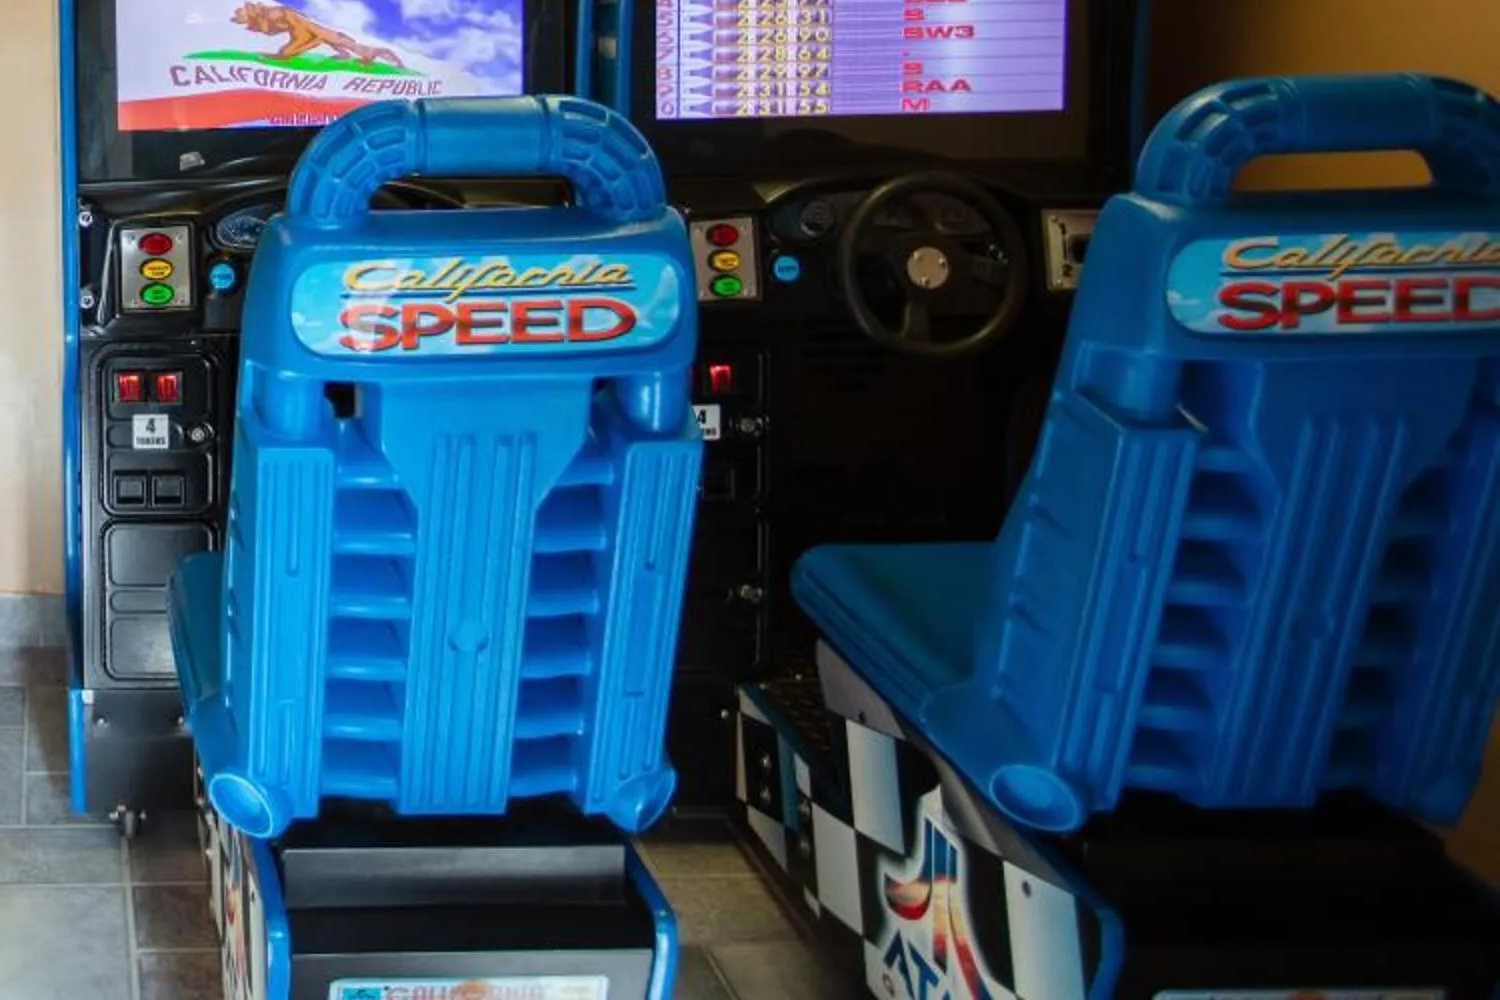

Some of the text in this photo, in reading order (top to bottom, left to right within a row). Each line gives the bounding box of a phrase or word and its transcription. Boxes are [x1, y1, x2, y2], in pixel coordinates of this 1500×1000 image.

[169, 64, 444, 97] CALIFORNIA REPUBLIC
[343, 257, 634, 304] California
[1217, 275, 1500, 330] SPEED
[339, 297, 638, 352] SPEED
[145, 417, 157, 434] 4
